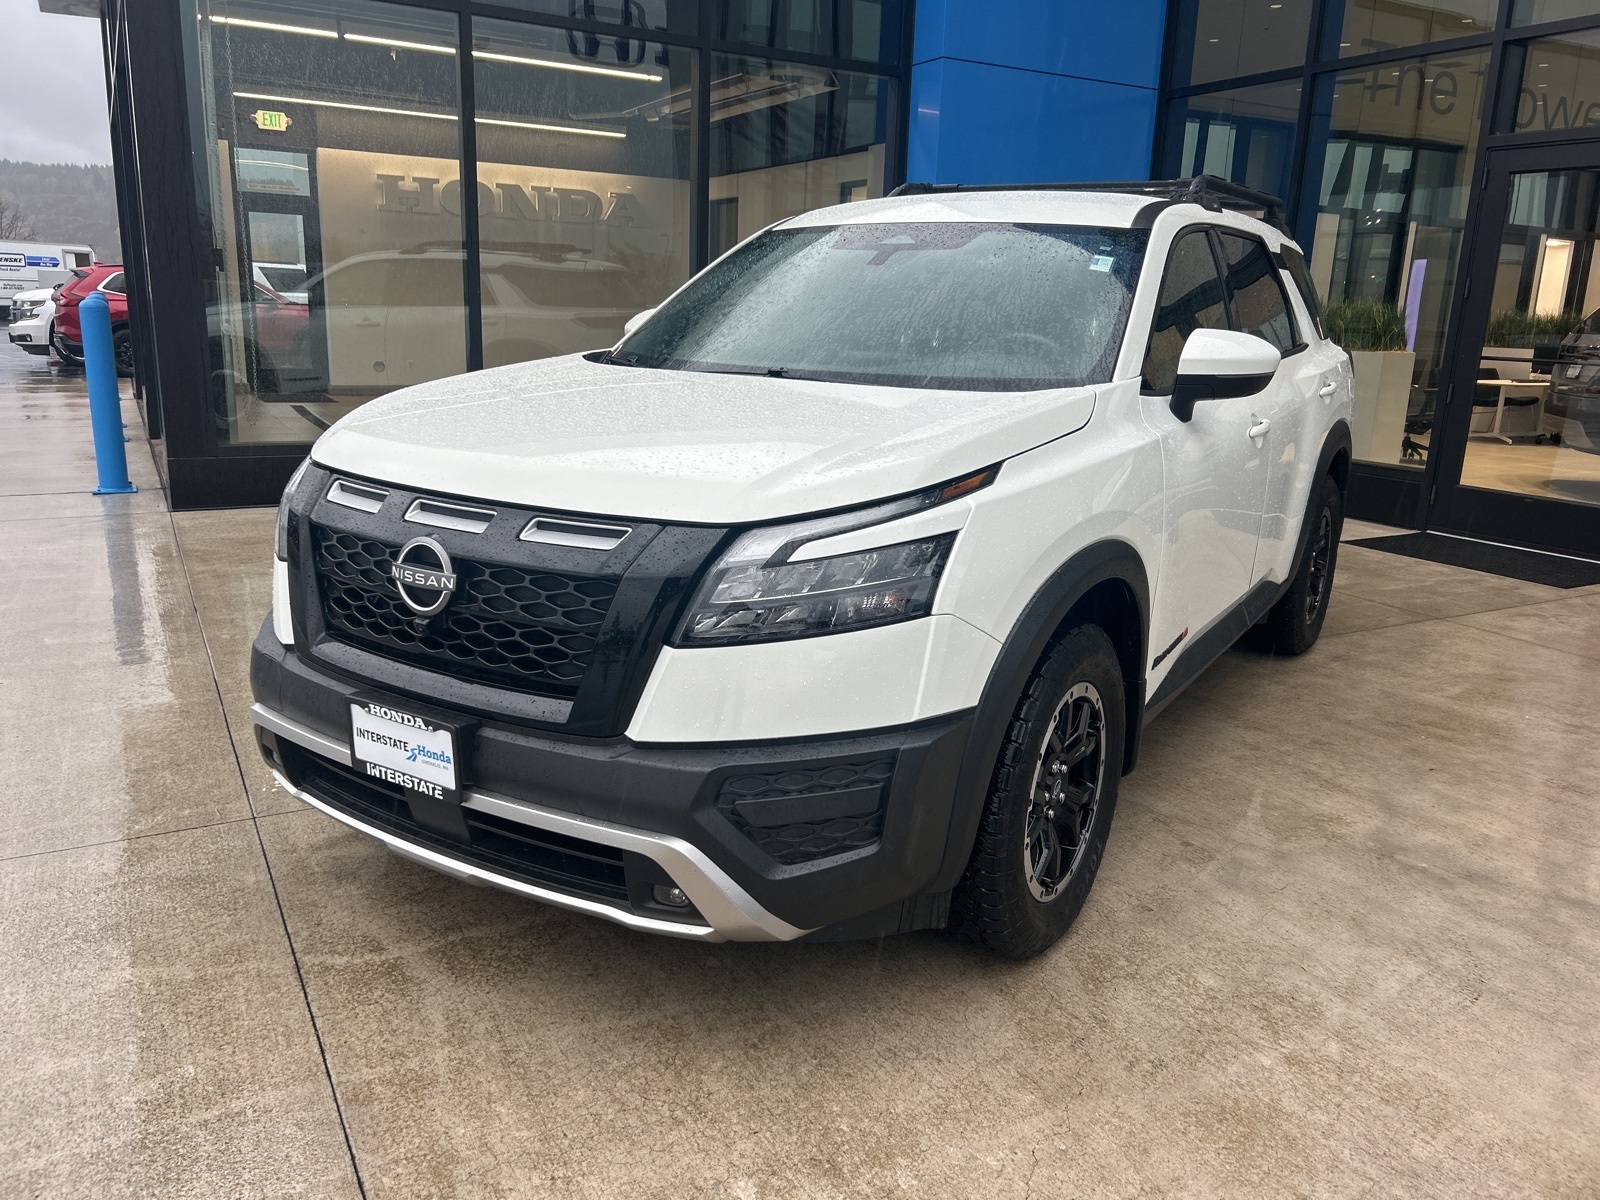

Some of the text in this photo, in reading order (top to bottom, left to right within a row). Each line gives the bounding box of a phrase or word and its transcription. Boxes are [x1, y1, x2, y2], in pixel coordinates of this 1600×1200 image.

[262, 112, 281, 128] EXIT
[376, 173, 649, 229] HONDA
[392, 565, 454, 589] NISSAN
[368, 703, 428, 730] HONDA
[356, 726, 410, 752] INTERSTATE
[416, 744, 452, 764] Honda
[366, 762, 444, 800] INTERSTATE
